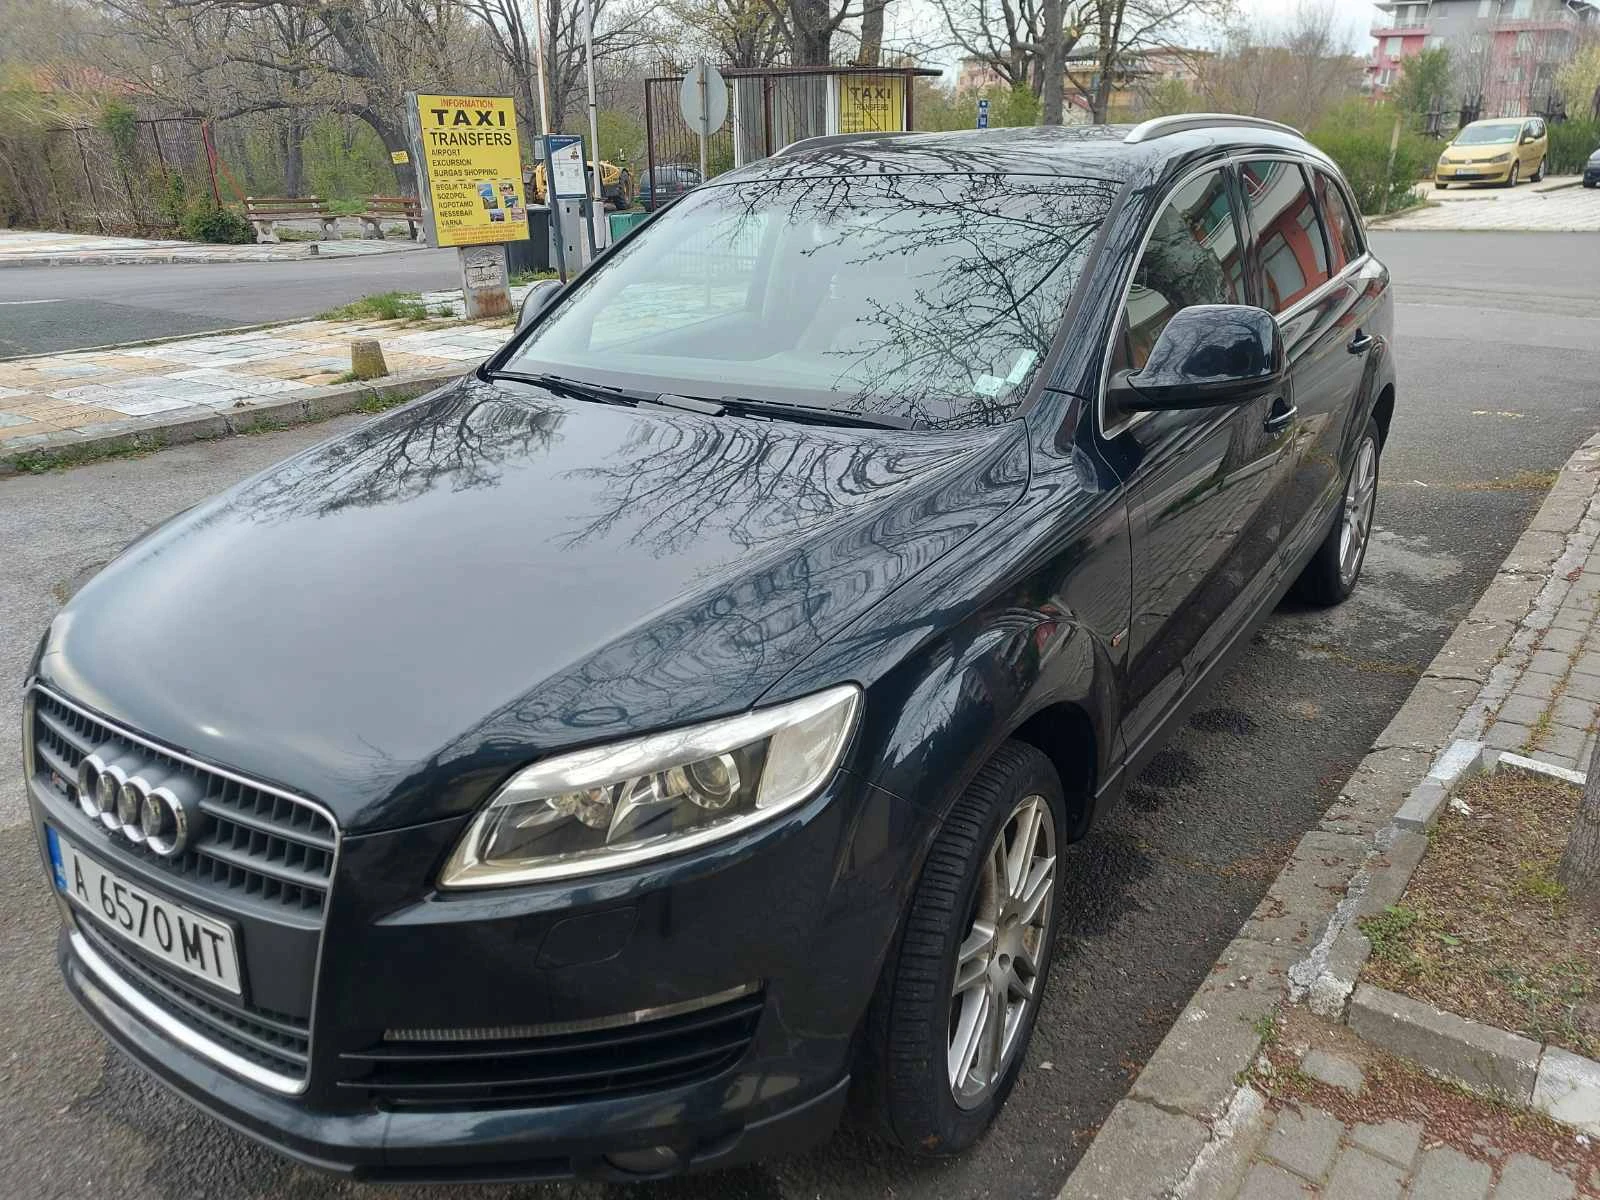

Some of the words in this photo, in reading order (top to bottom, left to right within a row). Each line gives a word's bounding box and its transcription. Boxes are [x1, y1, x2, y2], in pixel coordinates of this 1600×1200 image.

[849, 87, 891, 99] TAXI
[440, 98, 494, 109] INFORMATION
[430, 108, 506, 127] TAXI
[429, 131, 513, 146] TRANSFERS
[431, 148, 461, 156] AIRPORT
[432, 158, 472, 167] EXCURSION
[433, 169, 463, 177] BURGAS
[464, 168, 499, 177] SHOPPING
[437, 192, 467, 200] SOZOPOL
[439, 210, 473, 218] NESSEBAR
[440, 219, 463, 227] VARNA
[74, 854, 89, 901] A
[100, 875, 173, 953] 6570
[177, 915, 225, 978] MT
